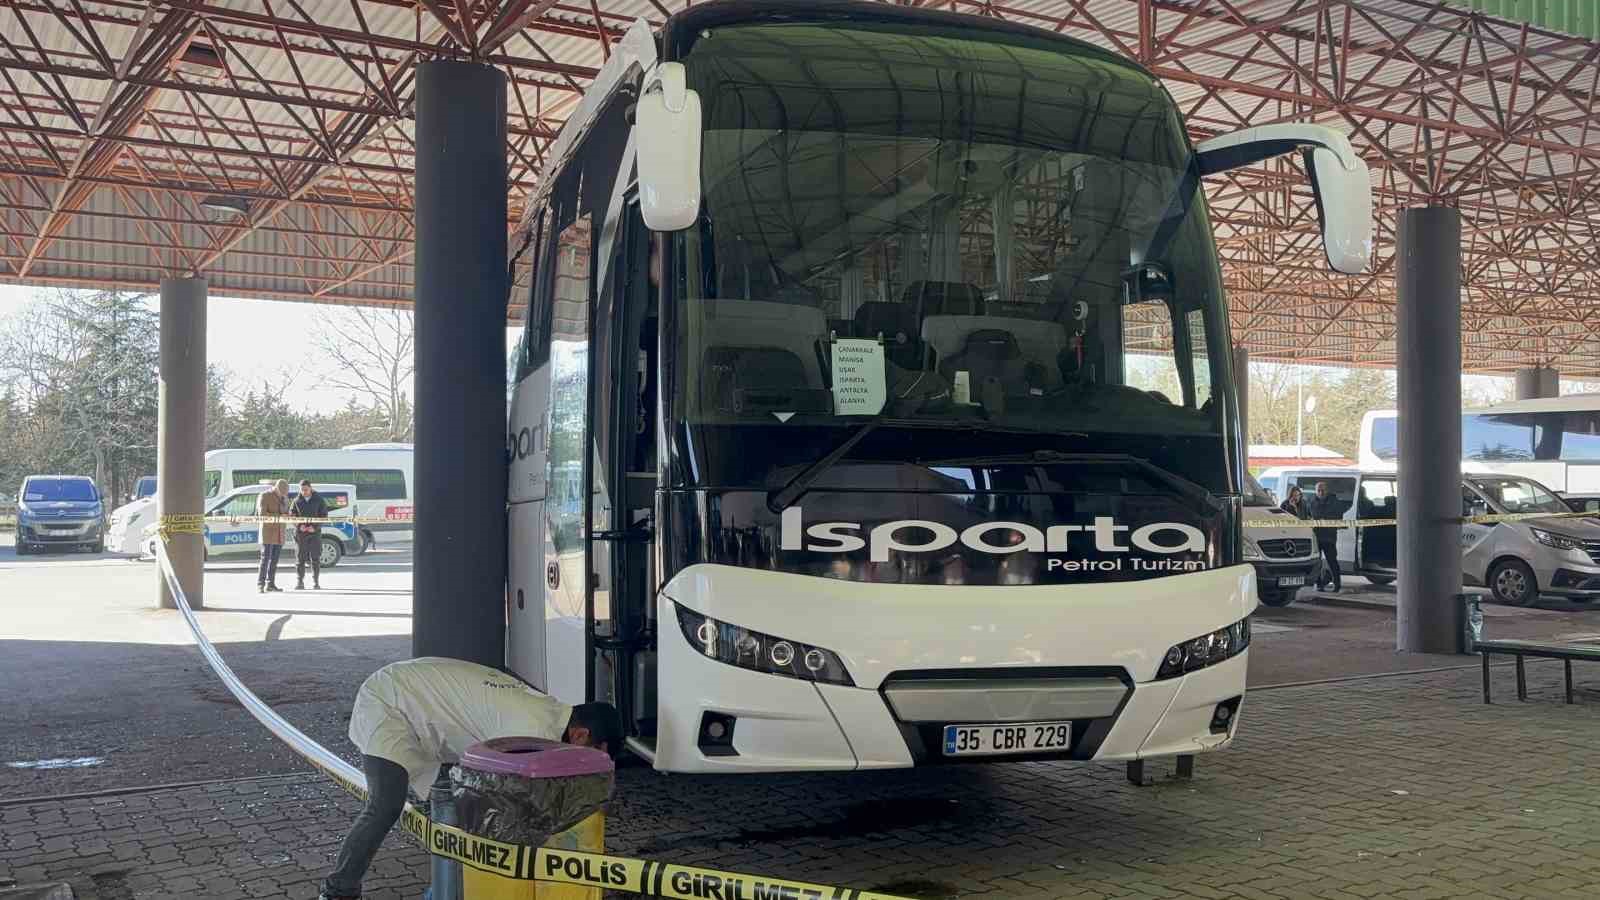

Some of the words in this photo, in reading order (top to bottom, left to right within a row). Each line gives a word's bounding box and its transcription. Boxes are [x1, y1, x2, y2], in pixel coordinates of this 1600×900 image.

[781, 507, 1206, 562] Isparta
[1047, 558, 1121, 571] Petrol
[1129, 558, 1206, 570] Turizm
[957, 729, 980, 751] 35
[993, 727, 1026, 750] CBR
[1033, 725, 1067, 748] 229
[433, 829, 511, 871] GİRİLMEZ
[545, 854, 628, 886] POLİS
